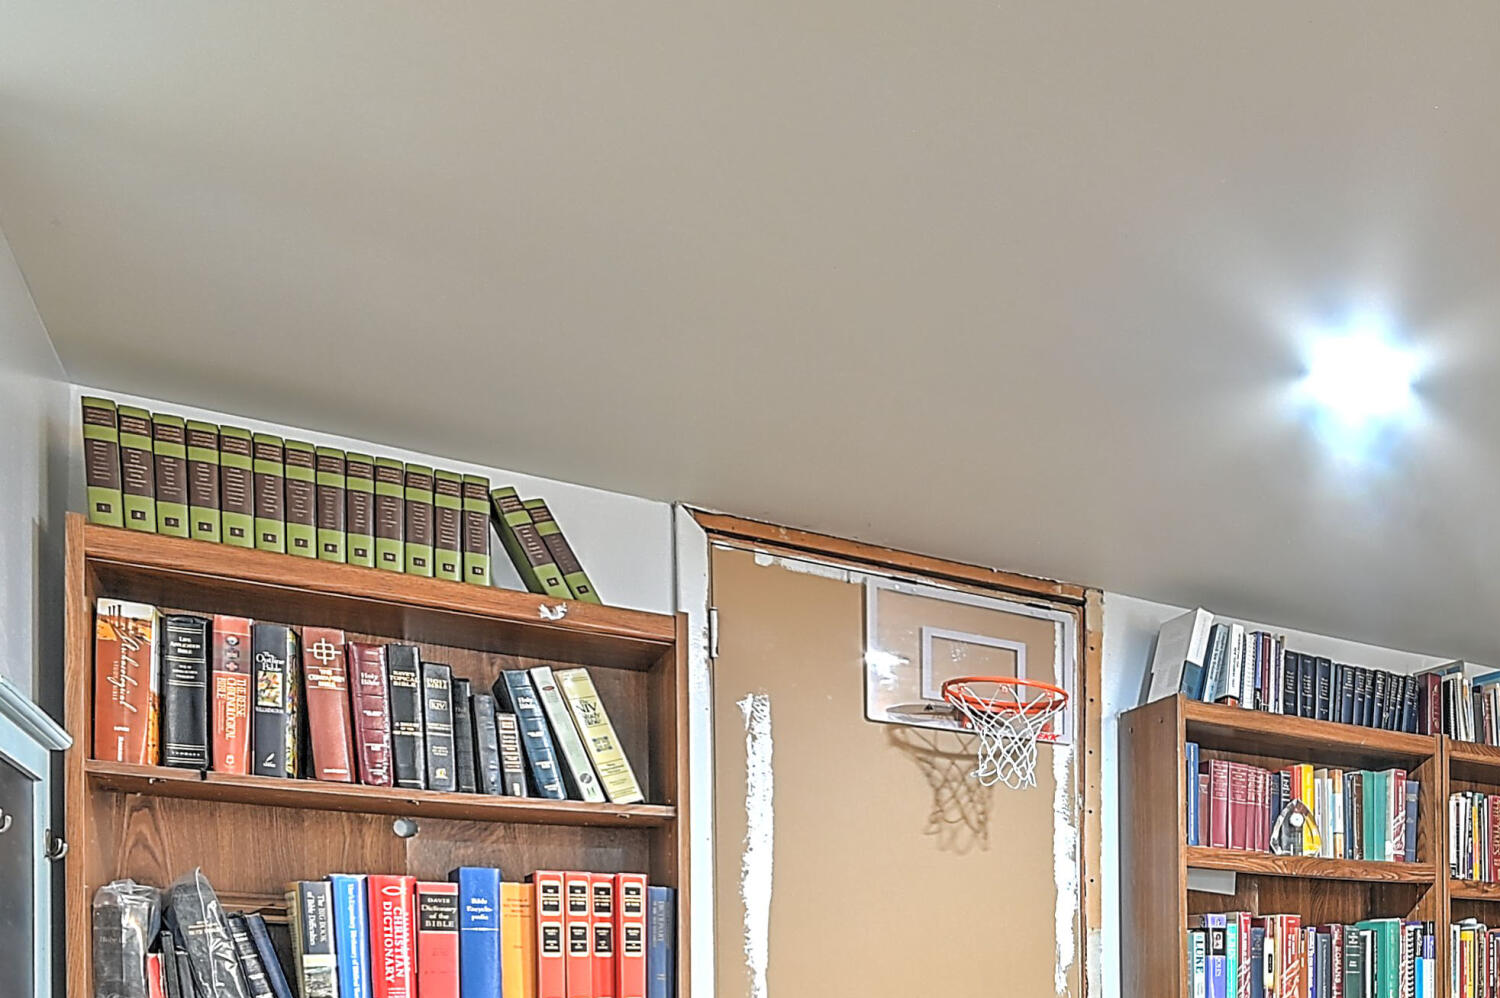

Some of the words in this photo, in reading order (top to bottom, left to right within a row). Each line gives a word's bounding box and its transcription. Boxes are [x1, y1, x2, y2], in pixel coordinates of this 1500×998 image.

[107, 636, 139, 713] Archaeological
[576, 702, 597, 713] NIV
[421, 904, 457, 914] Dictionary
[383, 901, 395, 983] DICTIONARY
[393, 907, 405, 978] CHRISTIAN
[1196, 940, 1204, 974] LUKE
